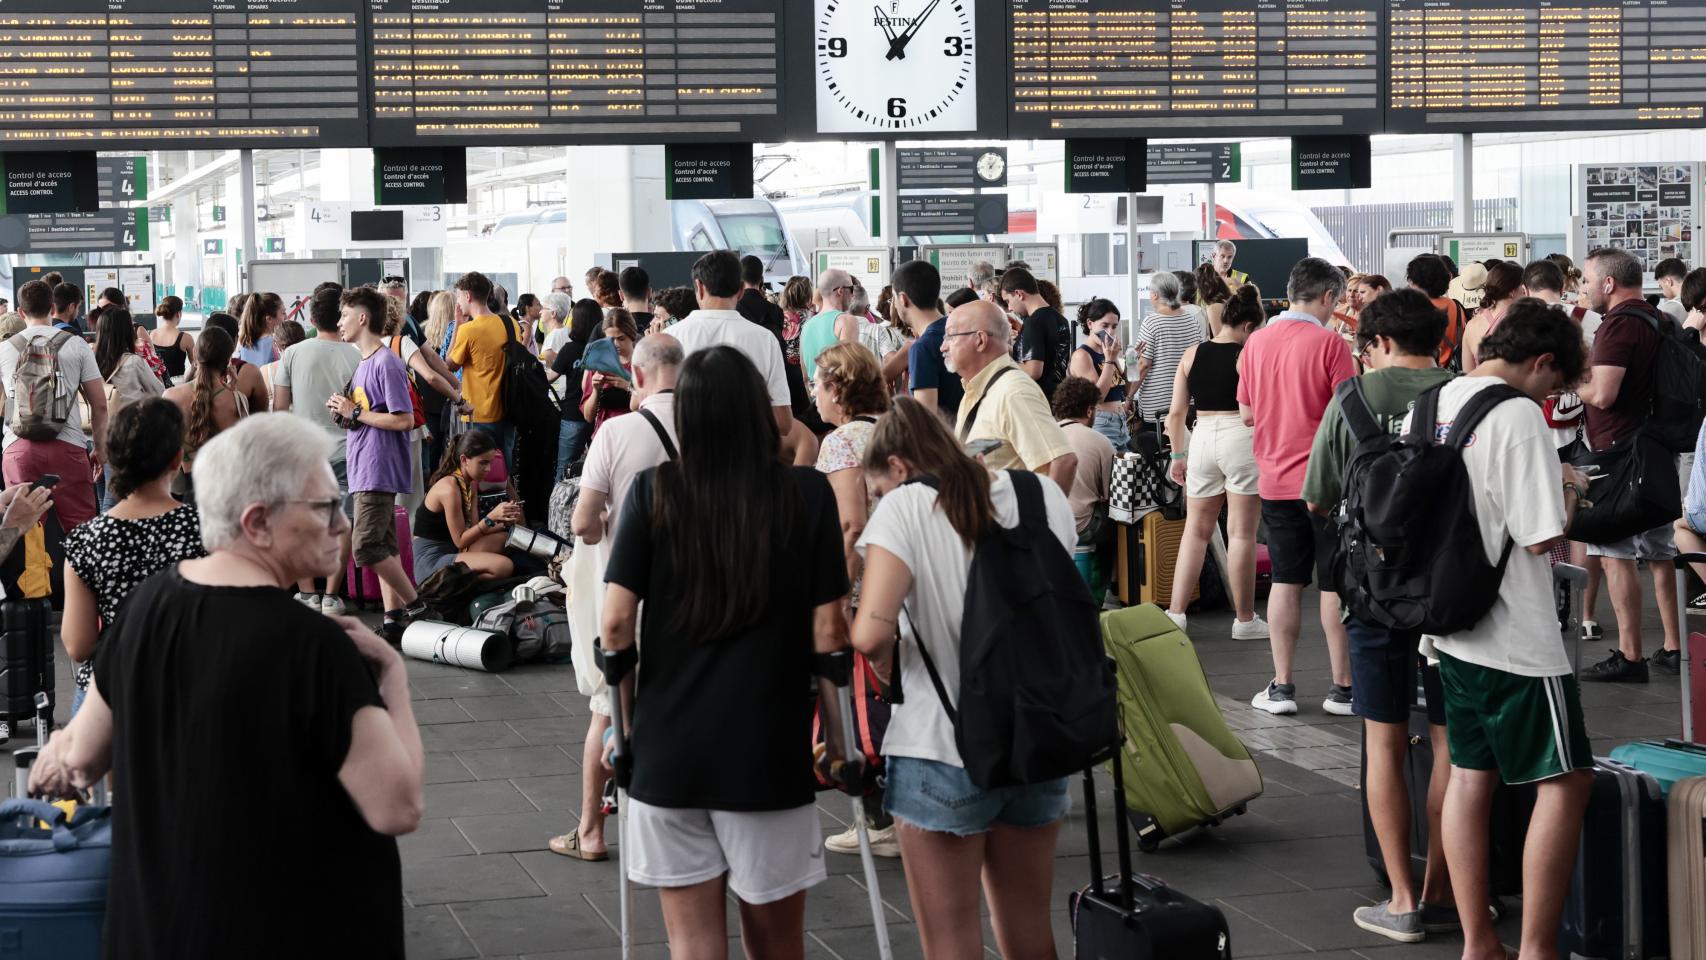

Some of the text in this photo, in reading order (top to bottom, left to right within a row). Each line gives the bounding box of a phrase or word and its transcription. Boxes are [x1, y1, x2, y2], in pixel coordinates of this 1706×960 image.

[873, 17, 918, 27] FESTINA
[827, 37, 848, 58] 9
[943, 36, 963, 57] 3
[887, 97, 907, 118] 6
[1073, 154, 1095, 162] Control
[8, 171, 35, 179] Control
[1222, 162, 1231, 178] 2
[9, 180, 33, 188] Control
[121, 179, 134, 196] 4
[1082, 194, 1091, 209] 2
[1188, 192, 1196, 207] 1
[311, 207, 322, 223] 4
[432, 206, 441, 222] 3
[123, 230, 136, 246] 4
